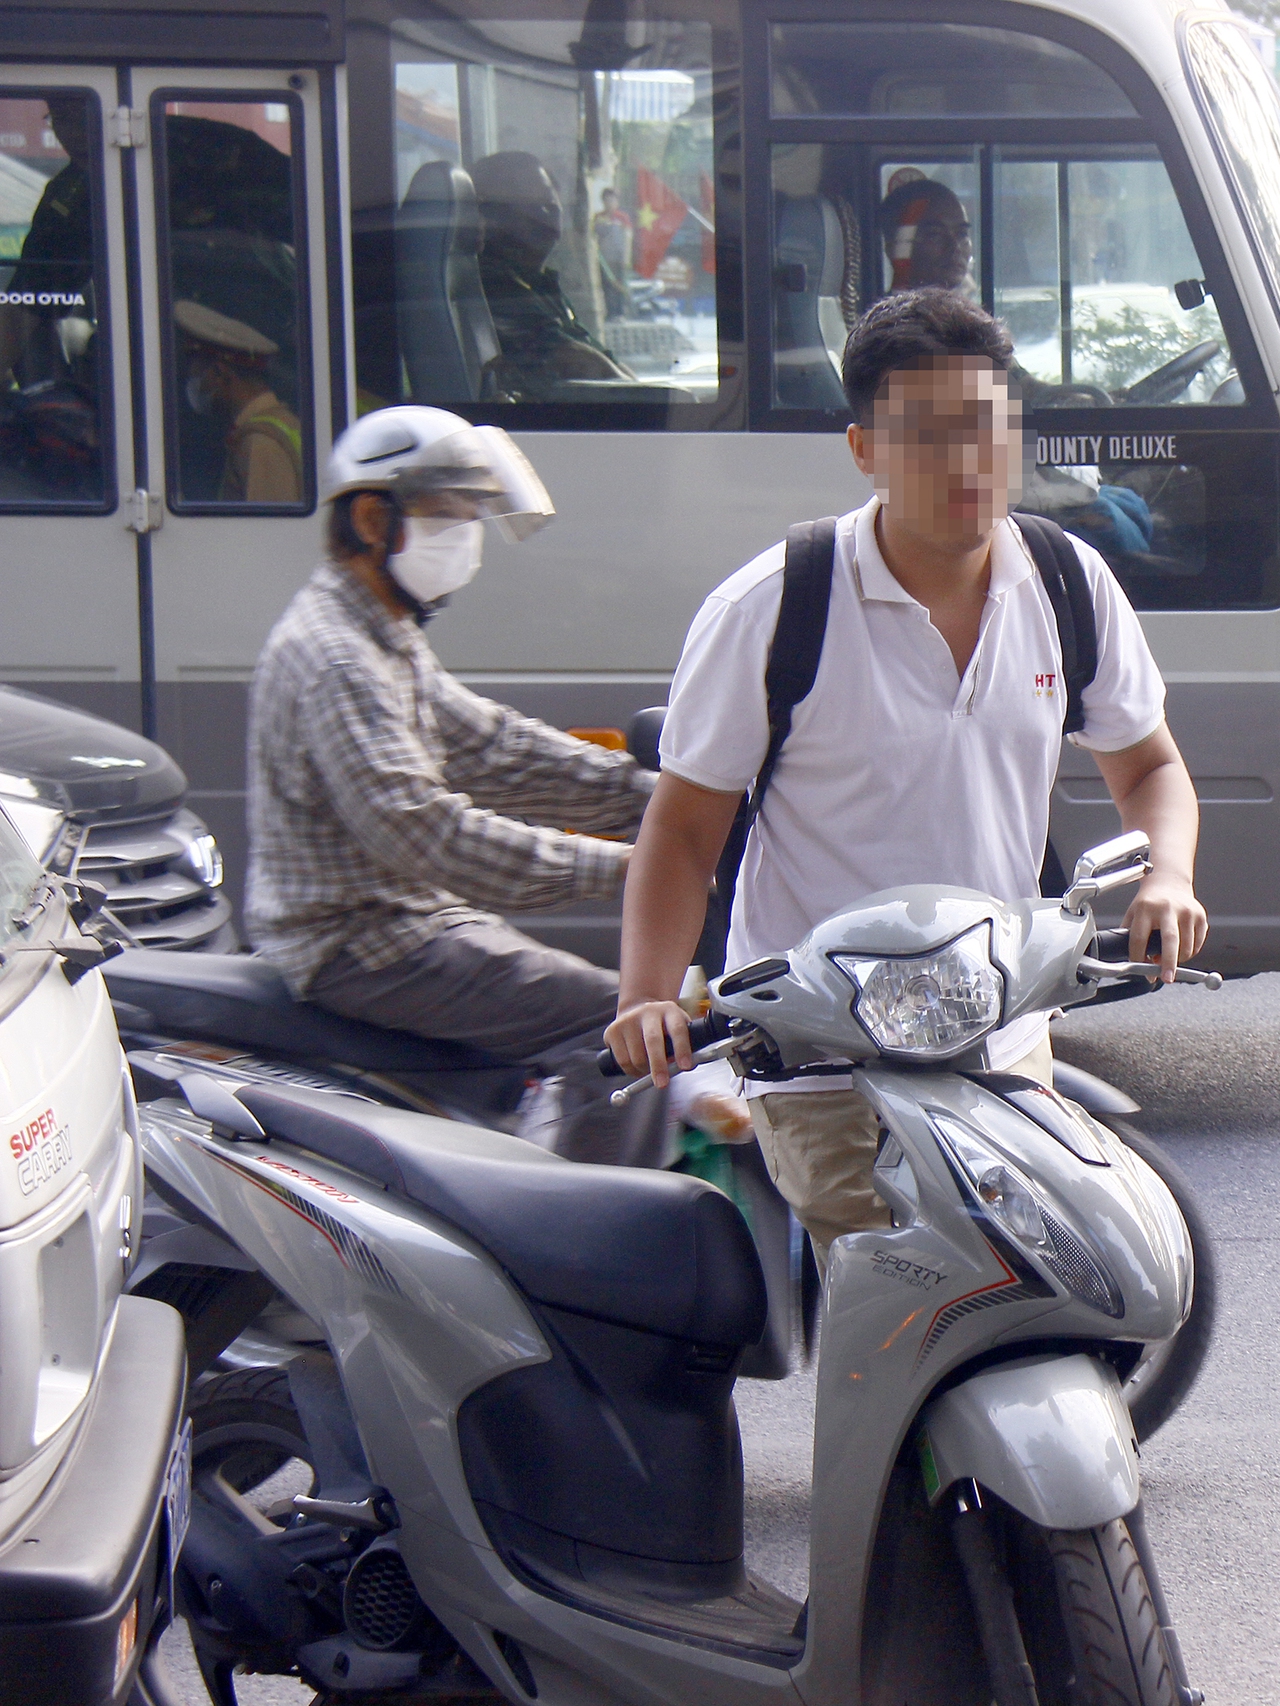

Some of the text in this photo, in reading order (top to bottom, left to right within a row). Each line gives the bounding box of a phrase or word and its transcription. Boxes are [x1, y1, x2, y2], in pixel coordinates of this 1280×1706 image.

[1036, 434, 1178, 465] OUNTY DELUXE
[10, 1107, 59, 1160] SUPER
[18, 1123, 72, 1197] CARRY
[869, 1249, 948, 1285] SPORTY
[872, 1264, 931, 1291] EDITION
